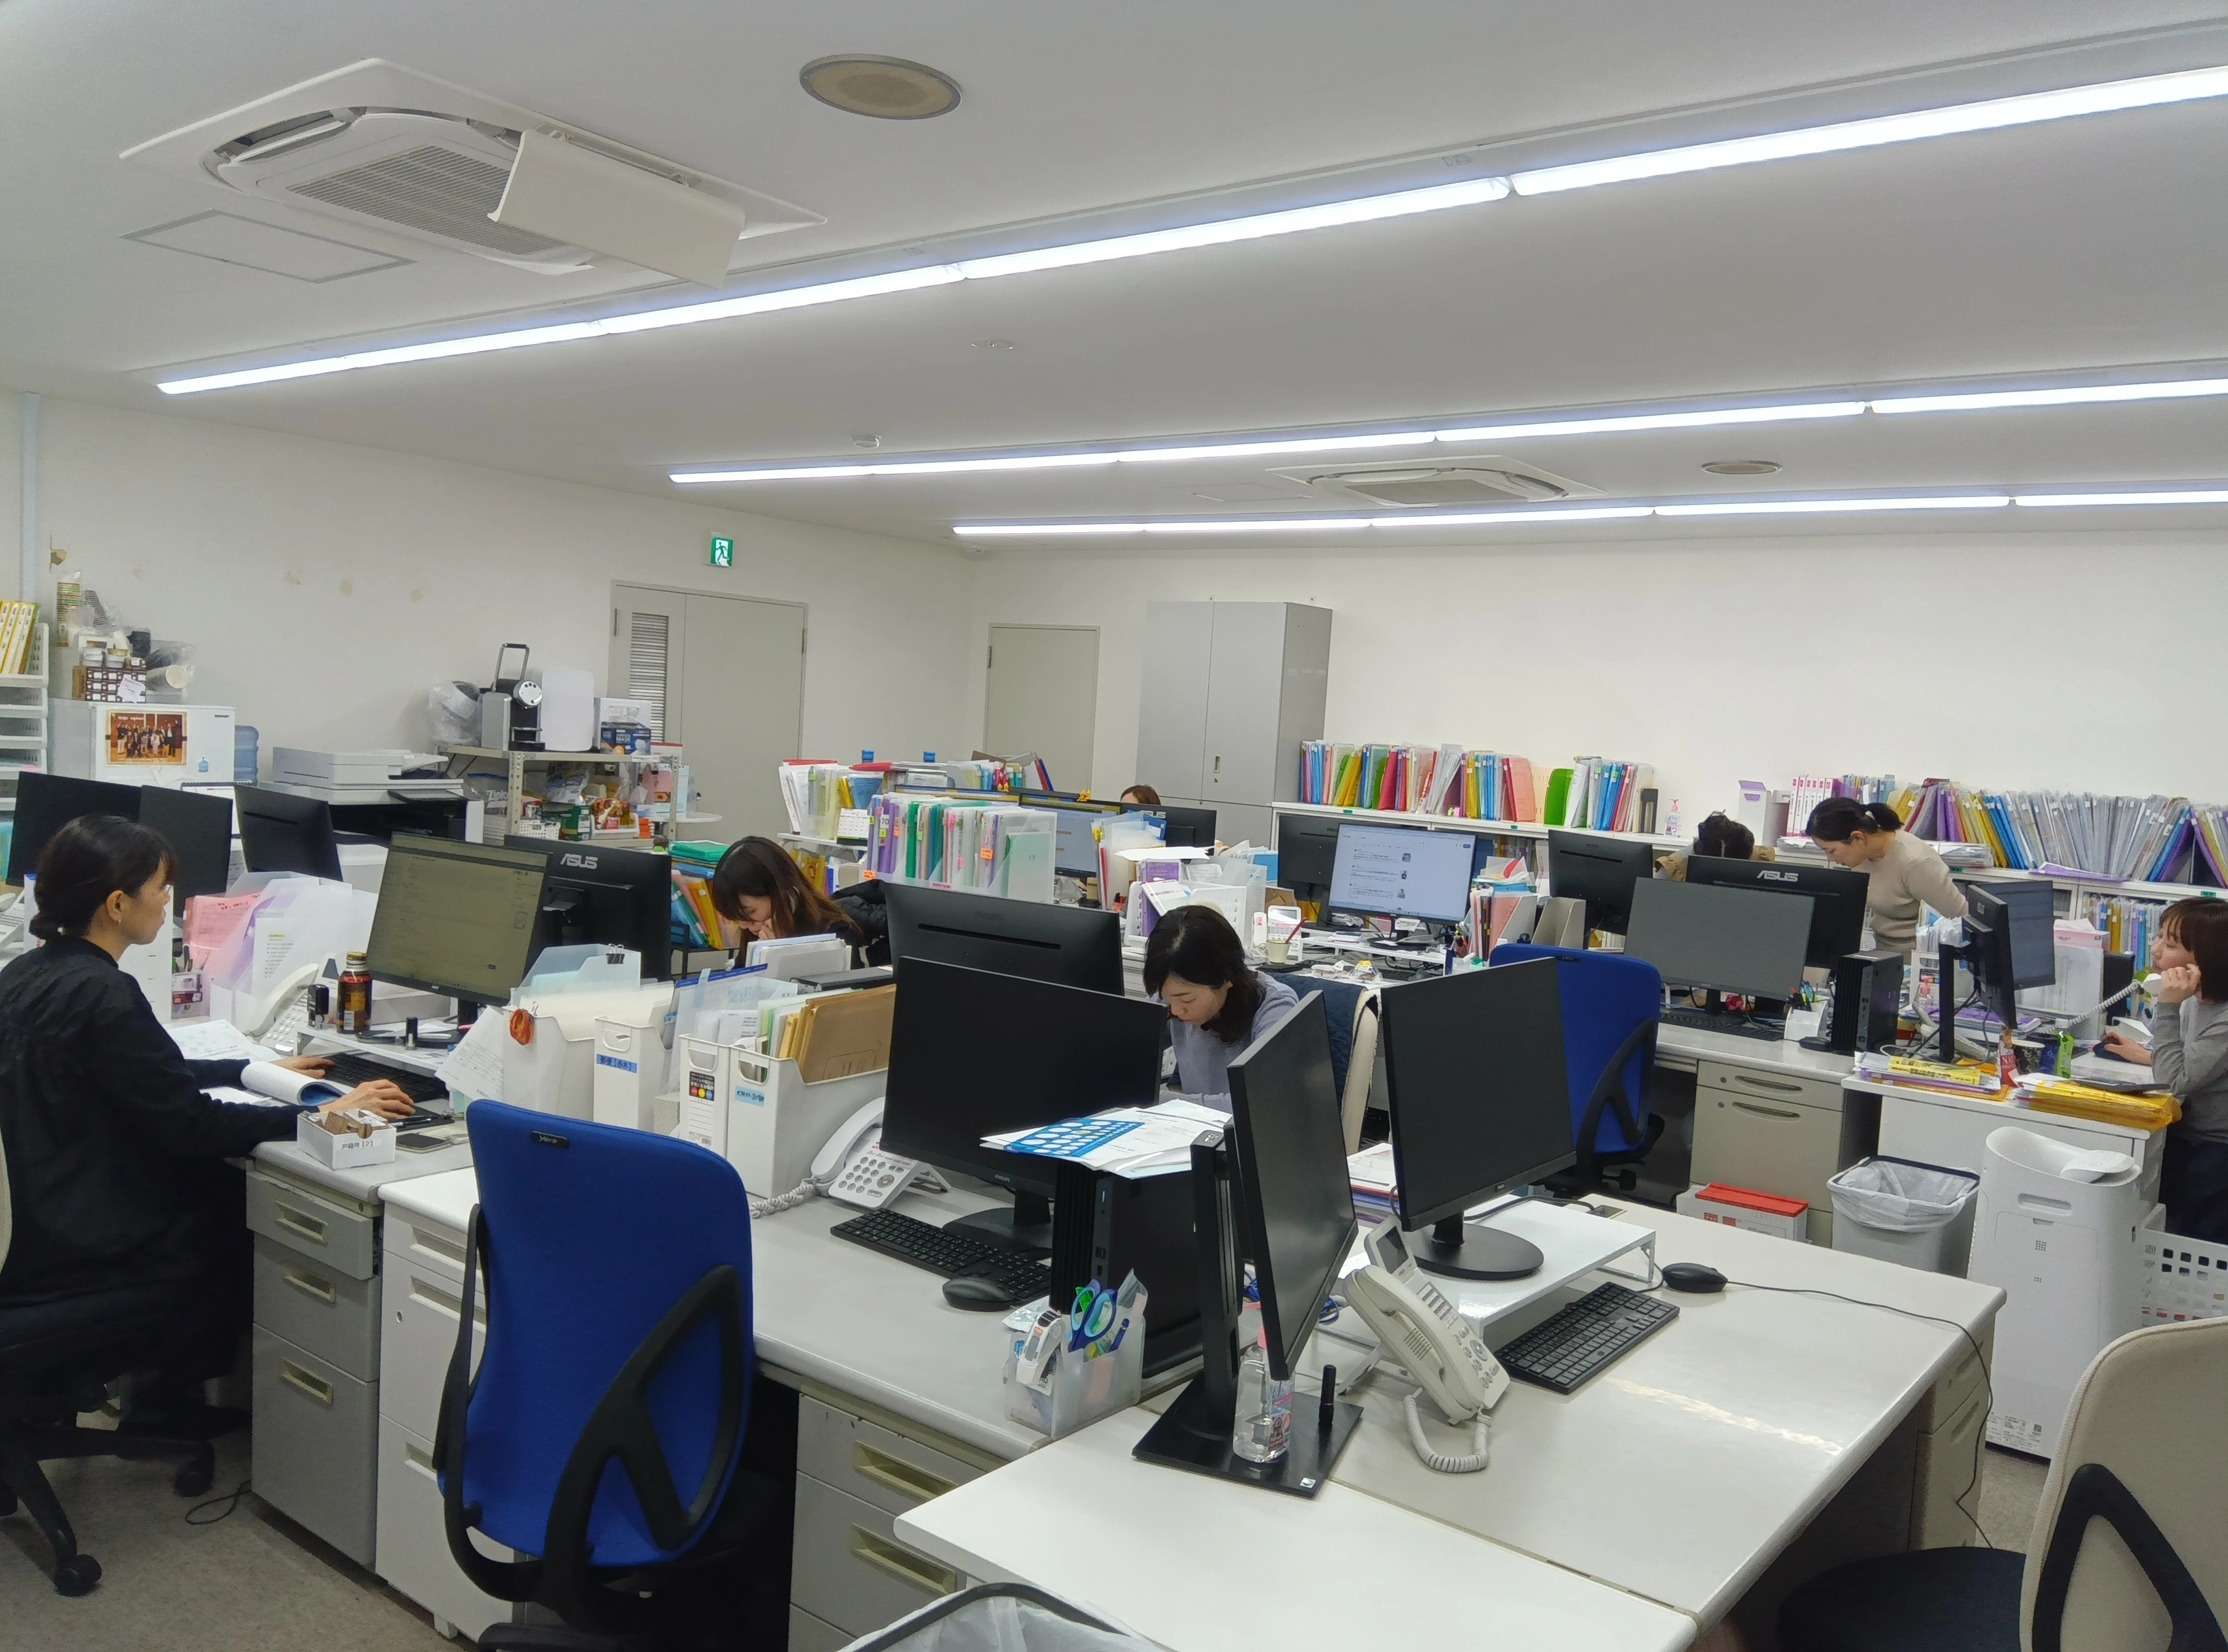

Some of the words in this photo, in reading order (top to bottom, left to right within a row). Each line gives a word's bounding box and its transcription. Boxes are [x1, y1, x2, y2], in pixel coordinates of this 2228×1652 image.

[487, 789, 508, 801] Ziplo
[560, 853, 598, 869] ASUS
[1756, 870, 1799, 882] ASUS
